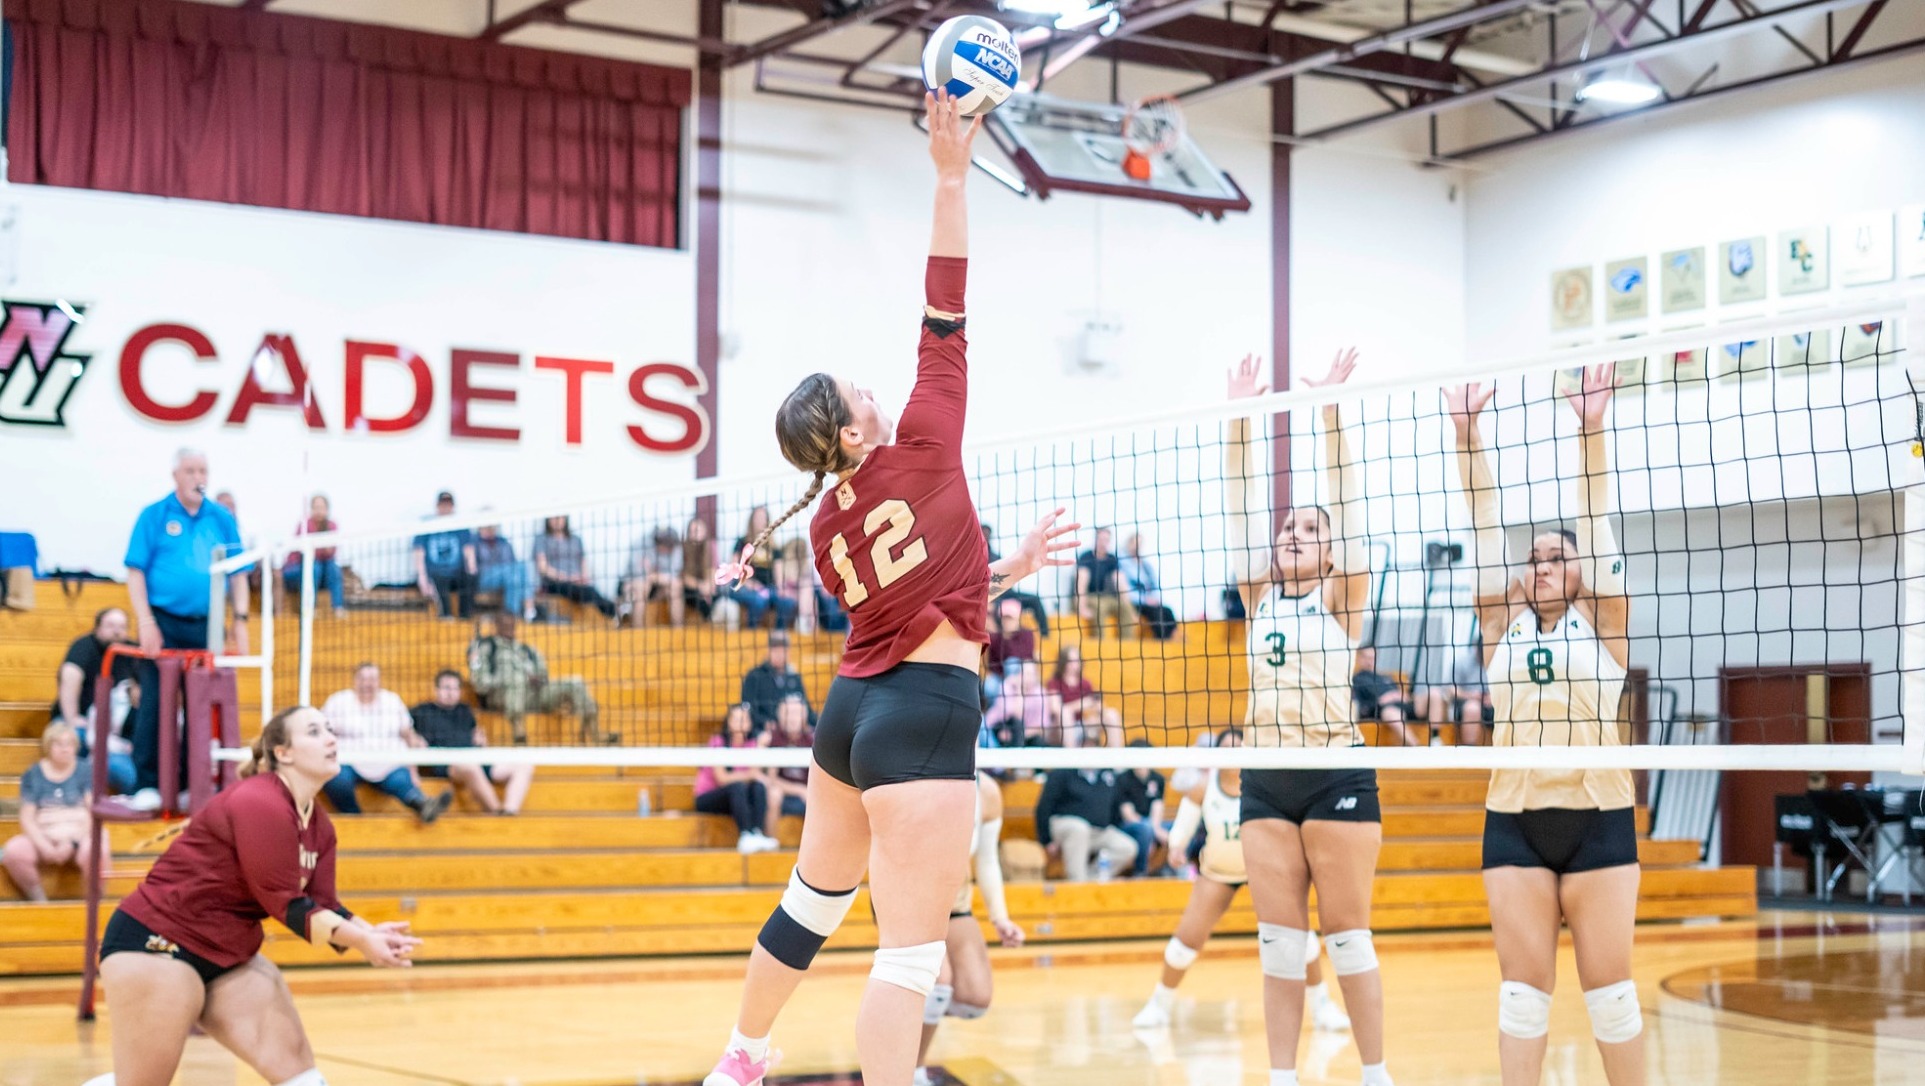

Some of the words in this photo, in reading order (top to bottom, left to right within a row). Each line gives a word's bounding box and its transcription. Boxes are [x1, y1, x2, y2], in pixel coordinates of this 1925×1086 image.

[973, 47, 1015, 80] NCAA
[976, 32, 1019, 66] molten
[117, 321, 704, 452] CADETS
[828, 498, 929, 609] 12
[1265, 631, 1286, 668] 3
[1526, 647, 1555, 686] 8
